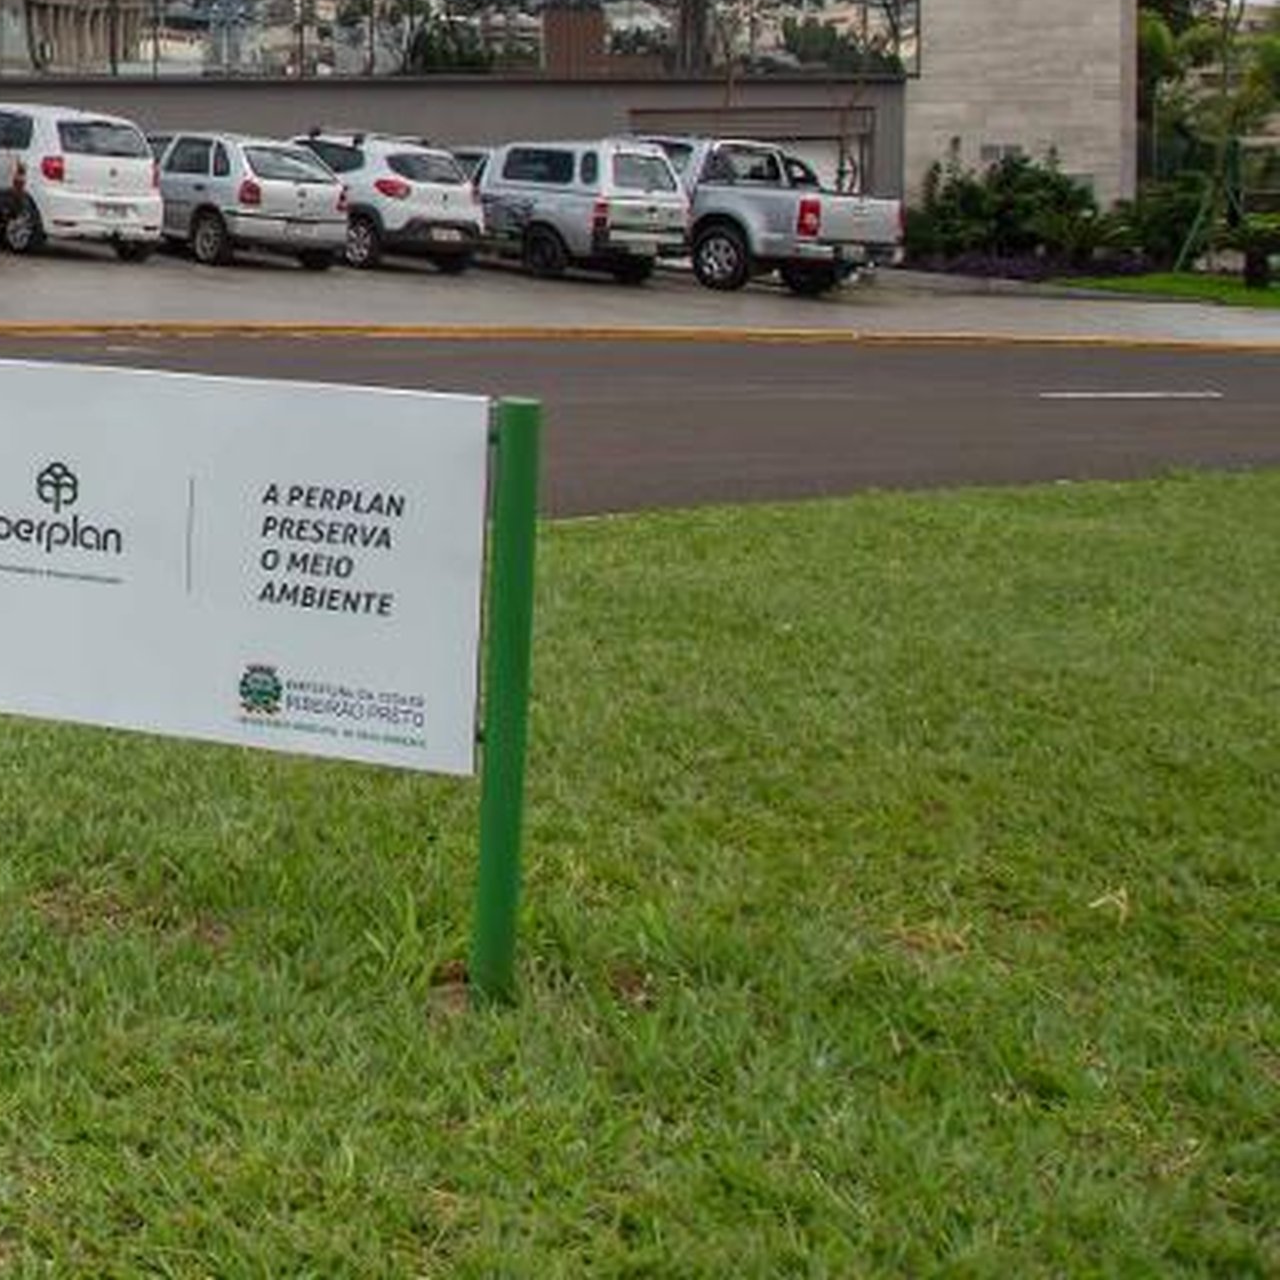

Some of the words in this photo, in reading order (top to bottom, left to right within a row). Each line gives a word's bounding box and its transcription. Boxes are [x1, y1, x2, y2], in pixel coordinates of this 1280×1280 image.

[262, 483, 279, 505] A
[287, 485, 405, 517] PERPLAN
[261, 516, 392, 549] PRESERVA
[260, 549, 280, 571] O
[286, 552, 354, 578] MEIO
[258, 581, 394, 617] AMBIENTE
